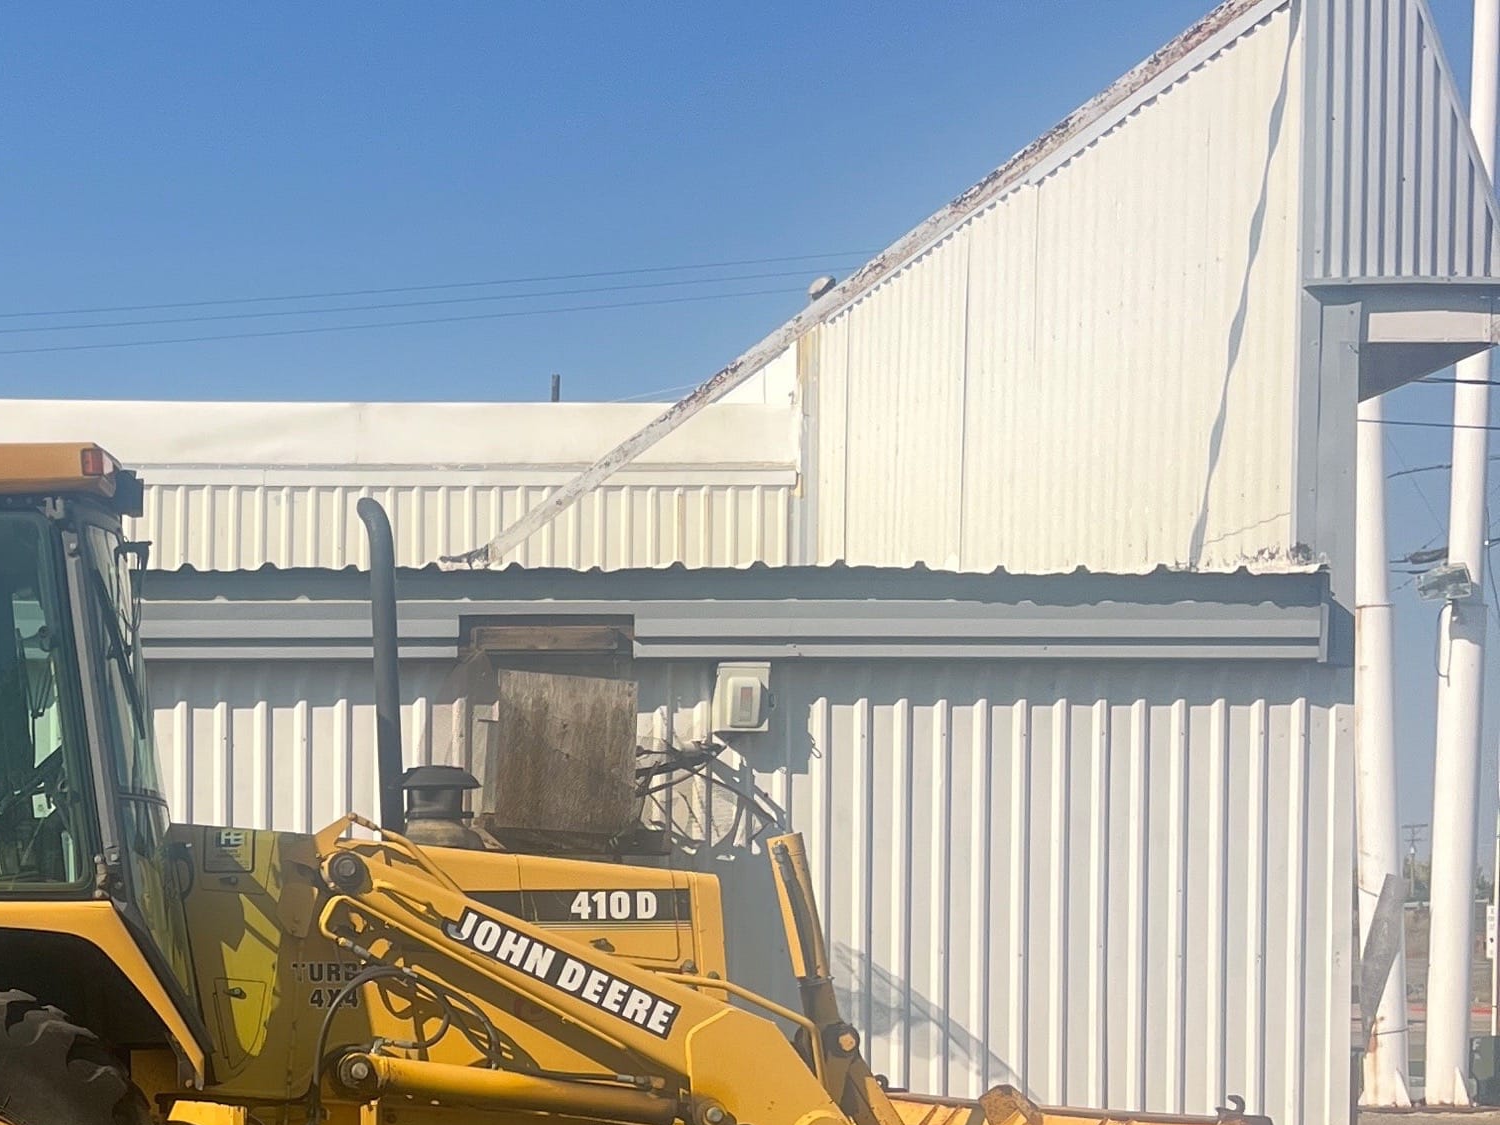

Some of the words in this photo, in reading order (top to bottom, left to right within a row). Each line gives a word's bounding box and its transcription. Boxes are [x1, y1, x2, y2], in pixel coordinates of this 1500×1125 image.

[570, 891, 630, 920] 410
[291, 961, 360, 983] TURB
[446, 911, 556, 980] JOHN
[555, 957, 677, 1036] DEERE
